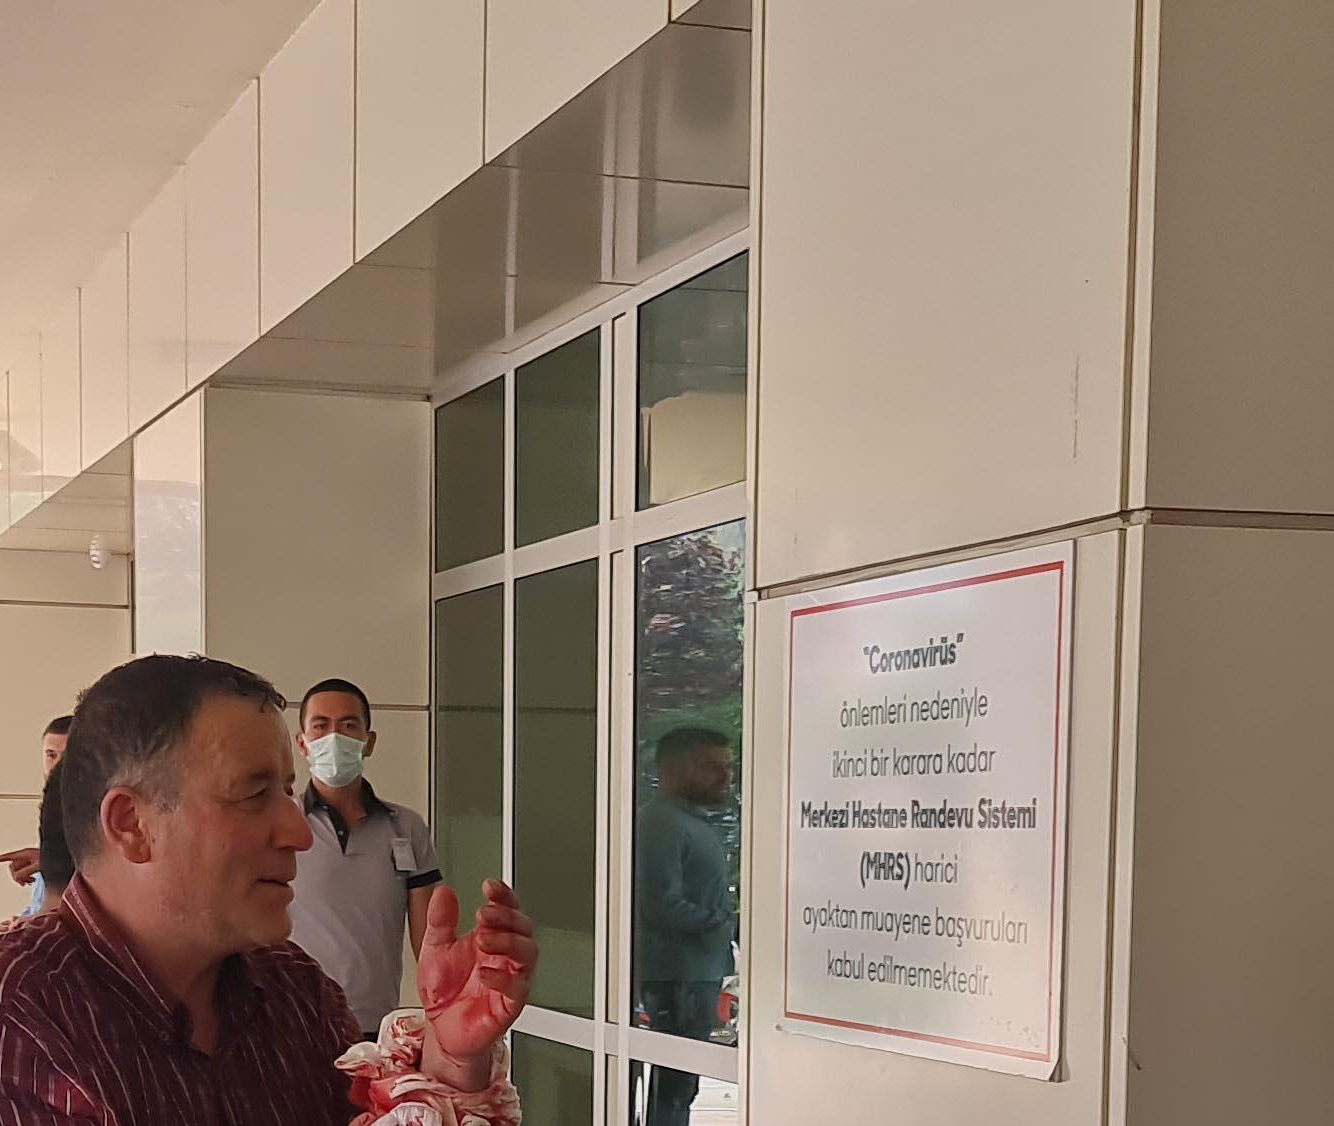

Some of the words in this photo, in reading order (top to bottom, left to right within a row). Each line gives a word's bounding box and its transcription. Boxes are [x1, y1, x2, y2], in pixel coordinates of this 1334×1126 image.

[840, 694, 907, 728] önlemleri
[910, 687, 988, 728] nedeniyle
[832, 746, 868, 778] ikinci
[871, 747, 887, 776] bir
[893, 744, 943, 776] karara
[947, 743, 996, 774] kadar
[800, 799, 849, 829] Merkezi
[852, 802, 907, 829] Hastane
[911, 799, 974, 829] Randevu
[977, 798, 1037, 829] Sistemi
[859, 851, 910, 890] (MHRS)
[914, 852, 959, 884] harici
[803, 900, 857, 934] ayaktan
[861, 909, 931, 942] muayene
[935, 906, 1028, 947] başvuruları
[827, 949, 864, 978] kabul
[867, 954, 994, 997] edilmemektedir.
